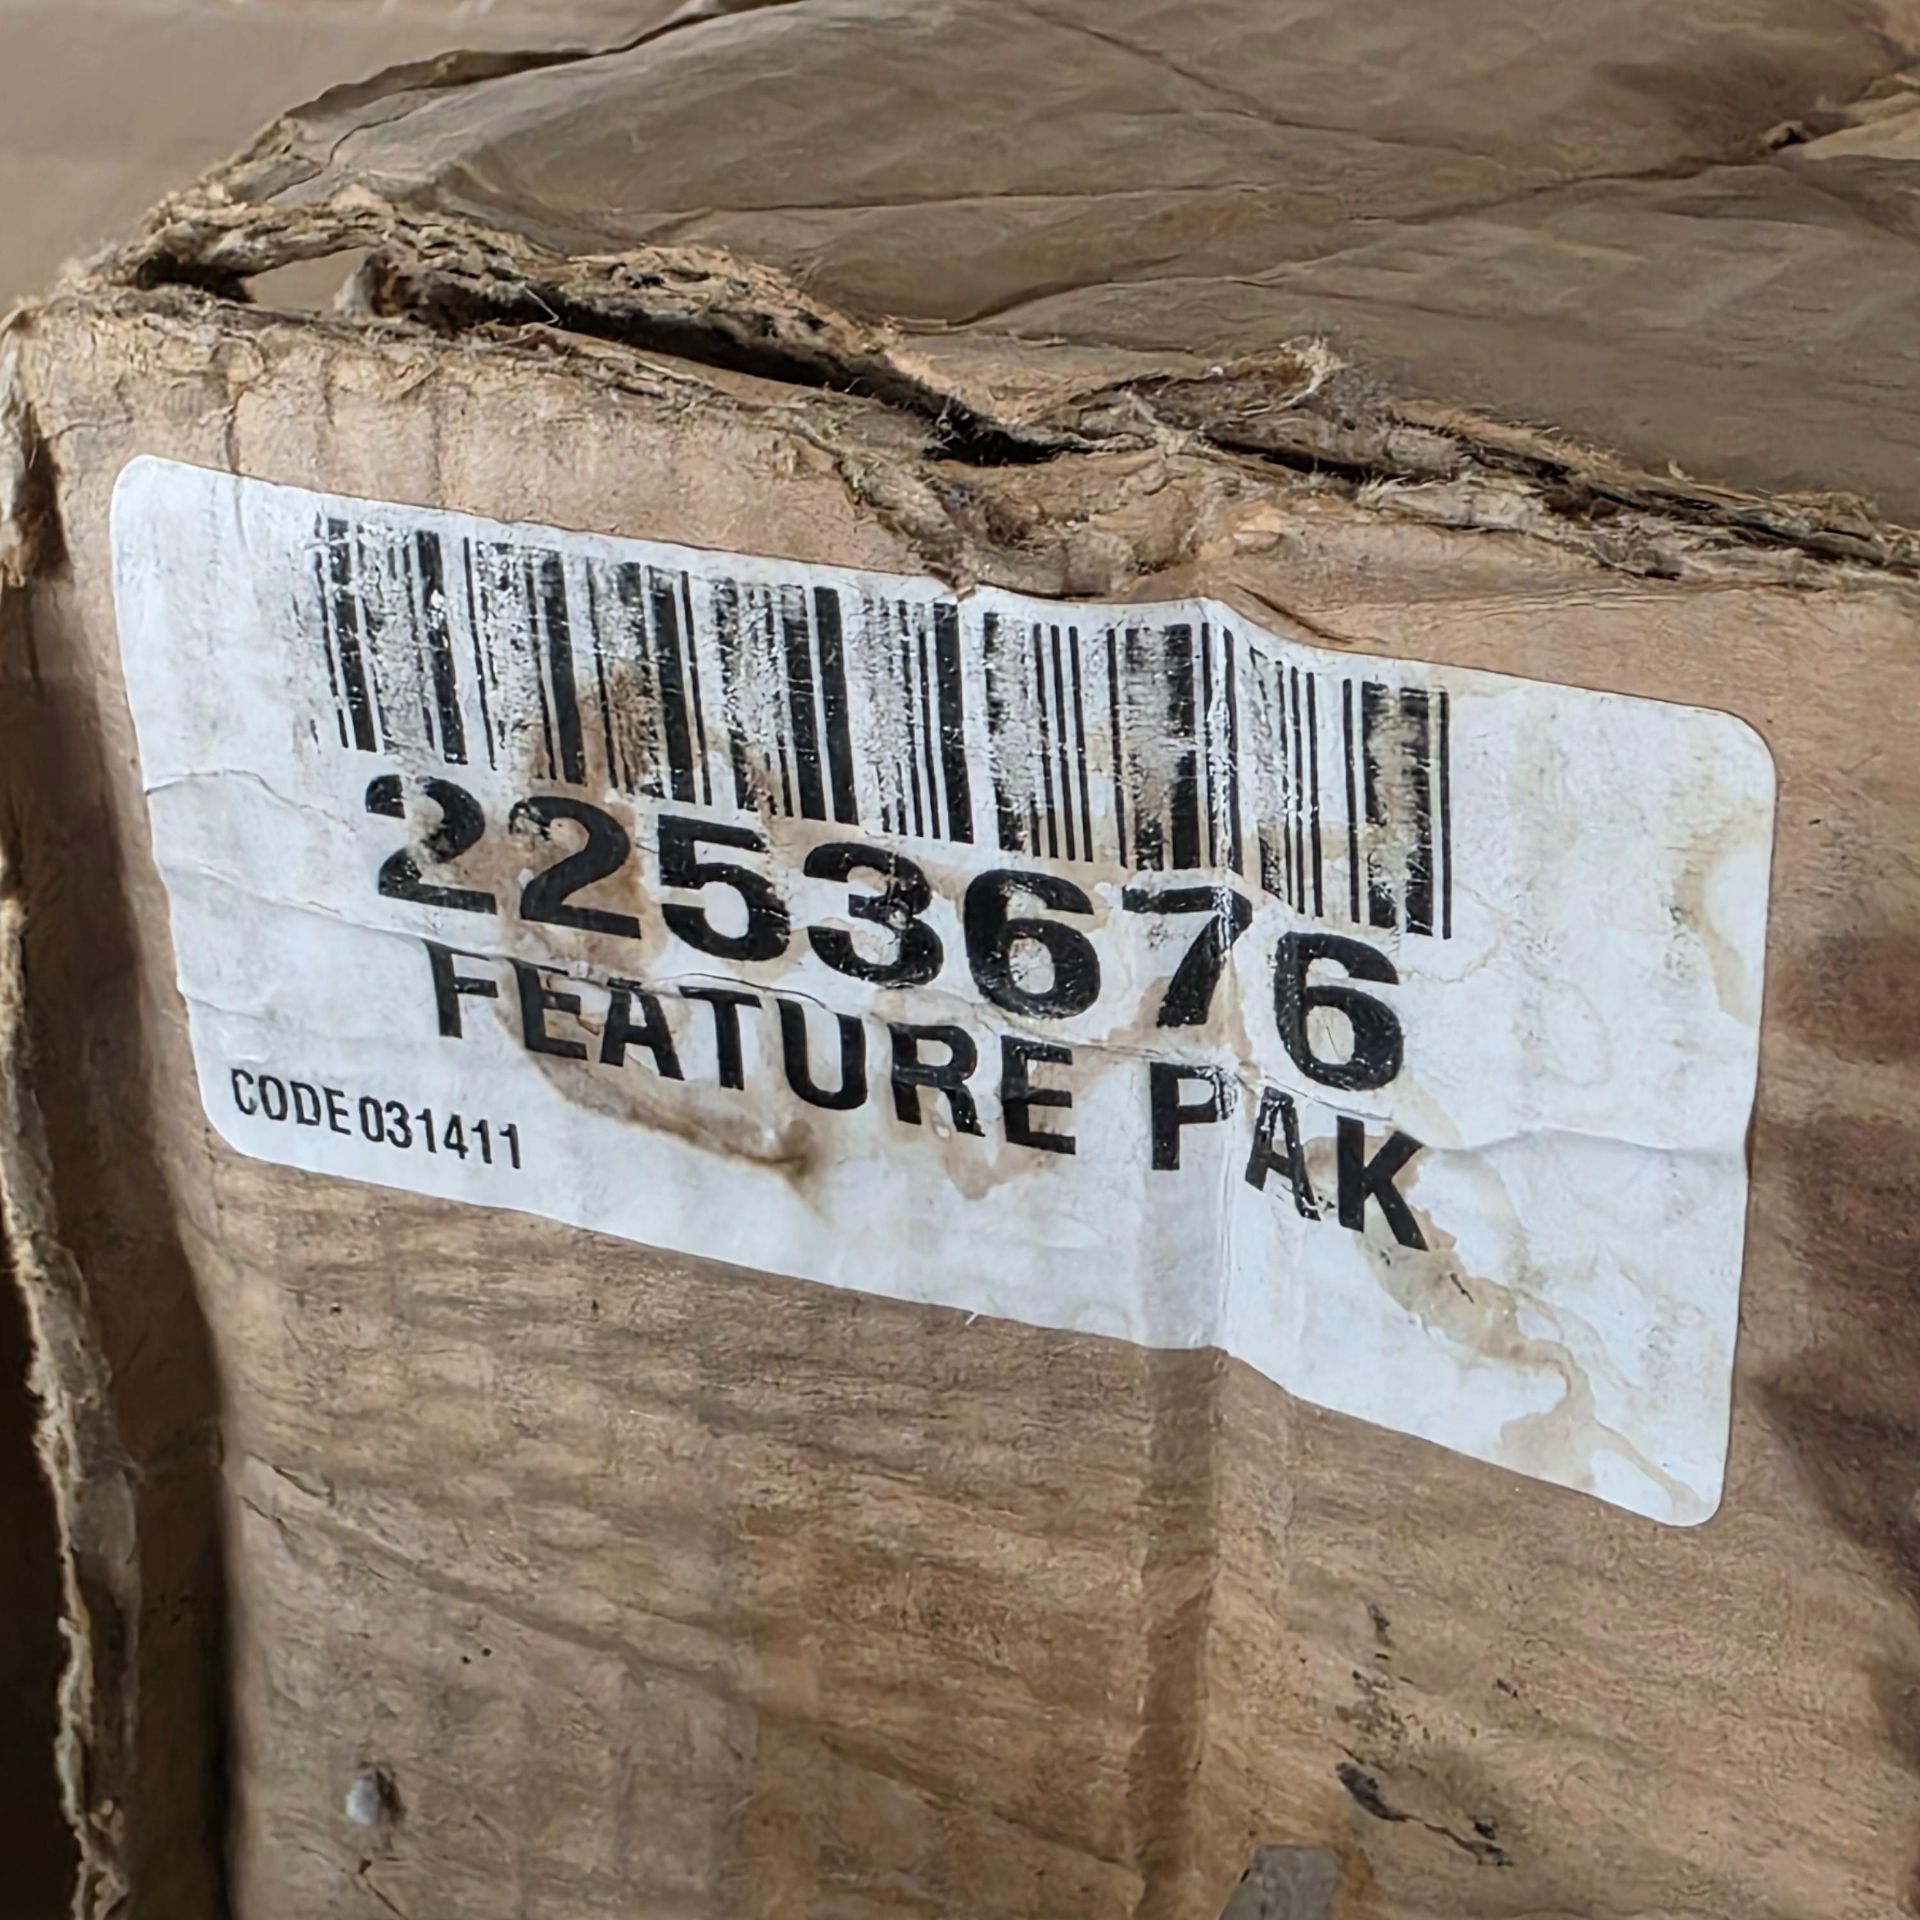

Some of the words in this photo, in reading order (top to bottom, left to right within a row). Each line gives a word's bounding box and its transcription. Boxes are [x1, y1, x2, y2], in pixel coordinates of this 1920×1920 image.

[366, 774, 1403, 1091] 2253676
[420, 939, 1076, 1155] FEATURE
[1150, 1062, 1428, 1251] PAK
